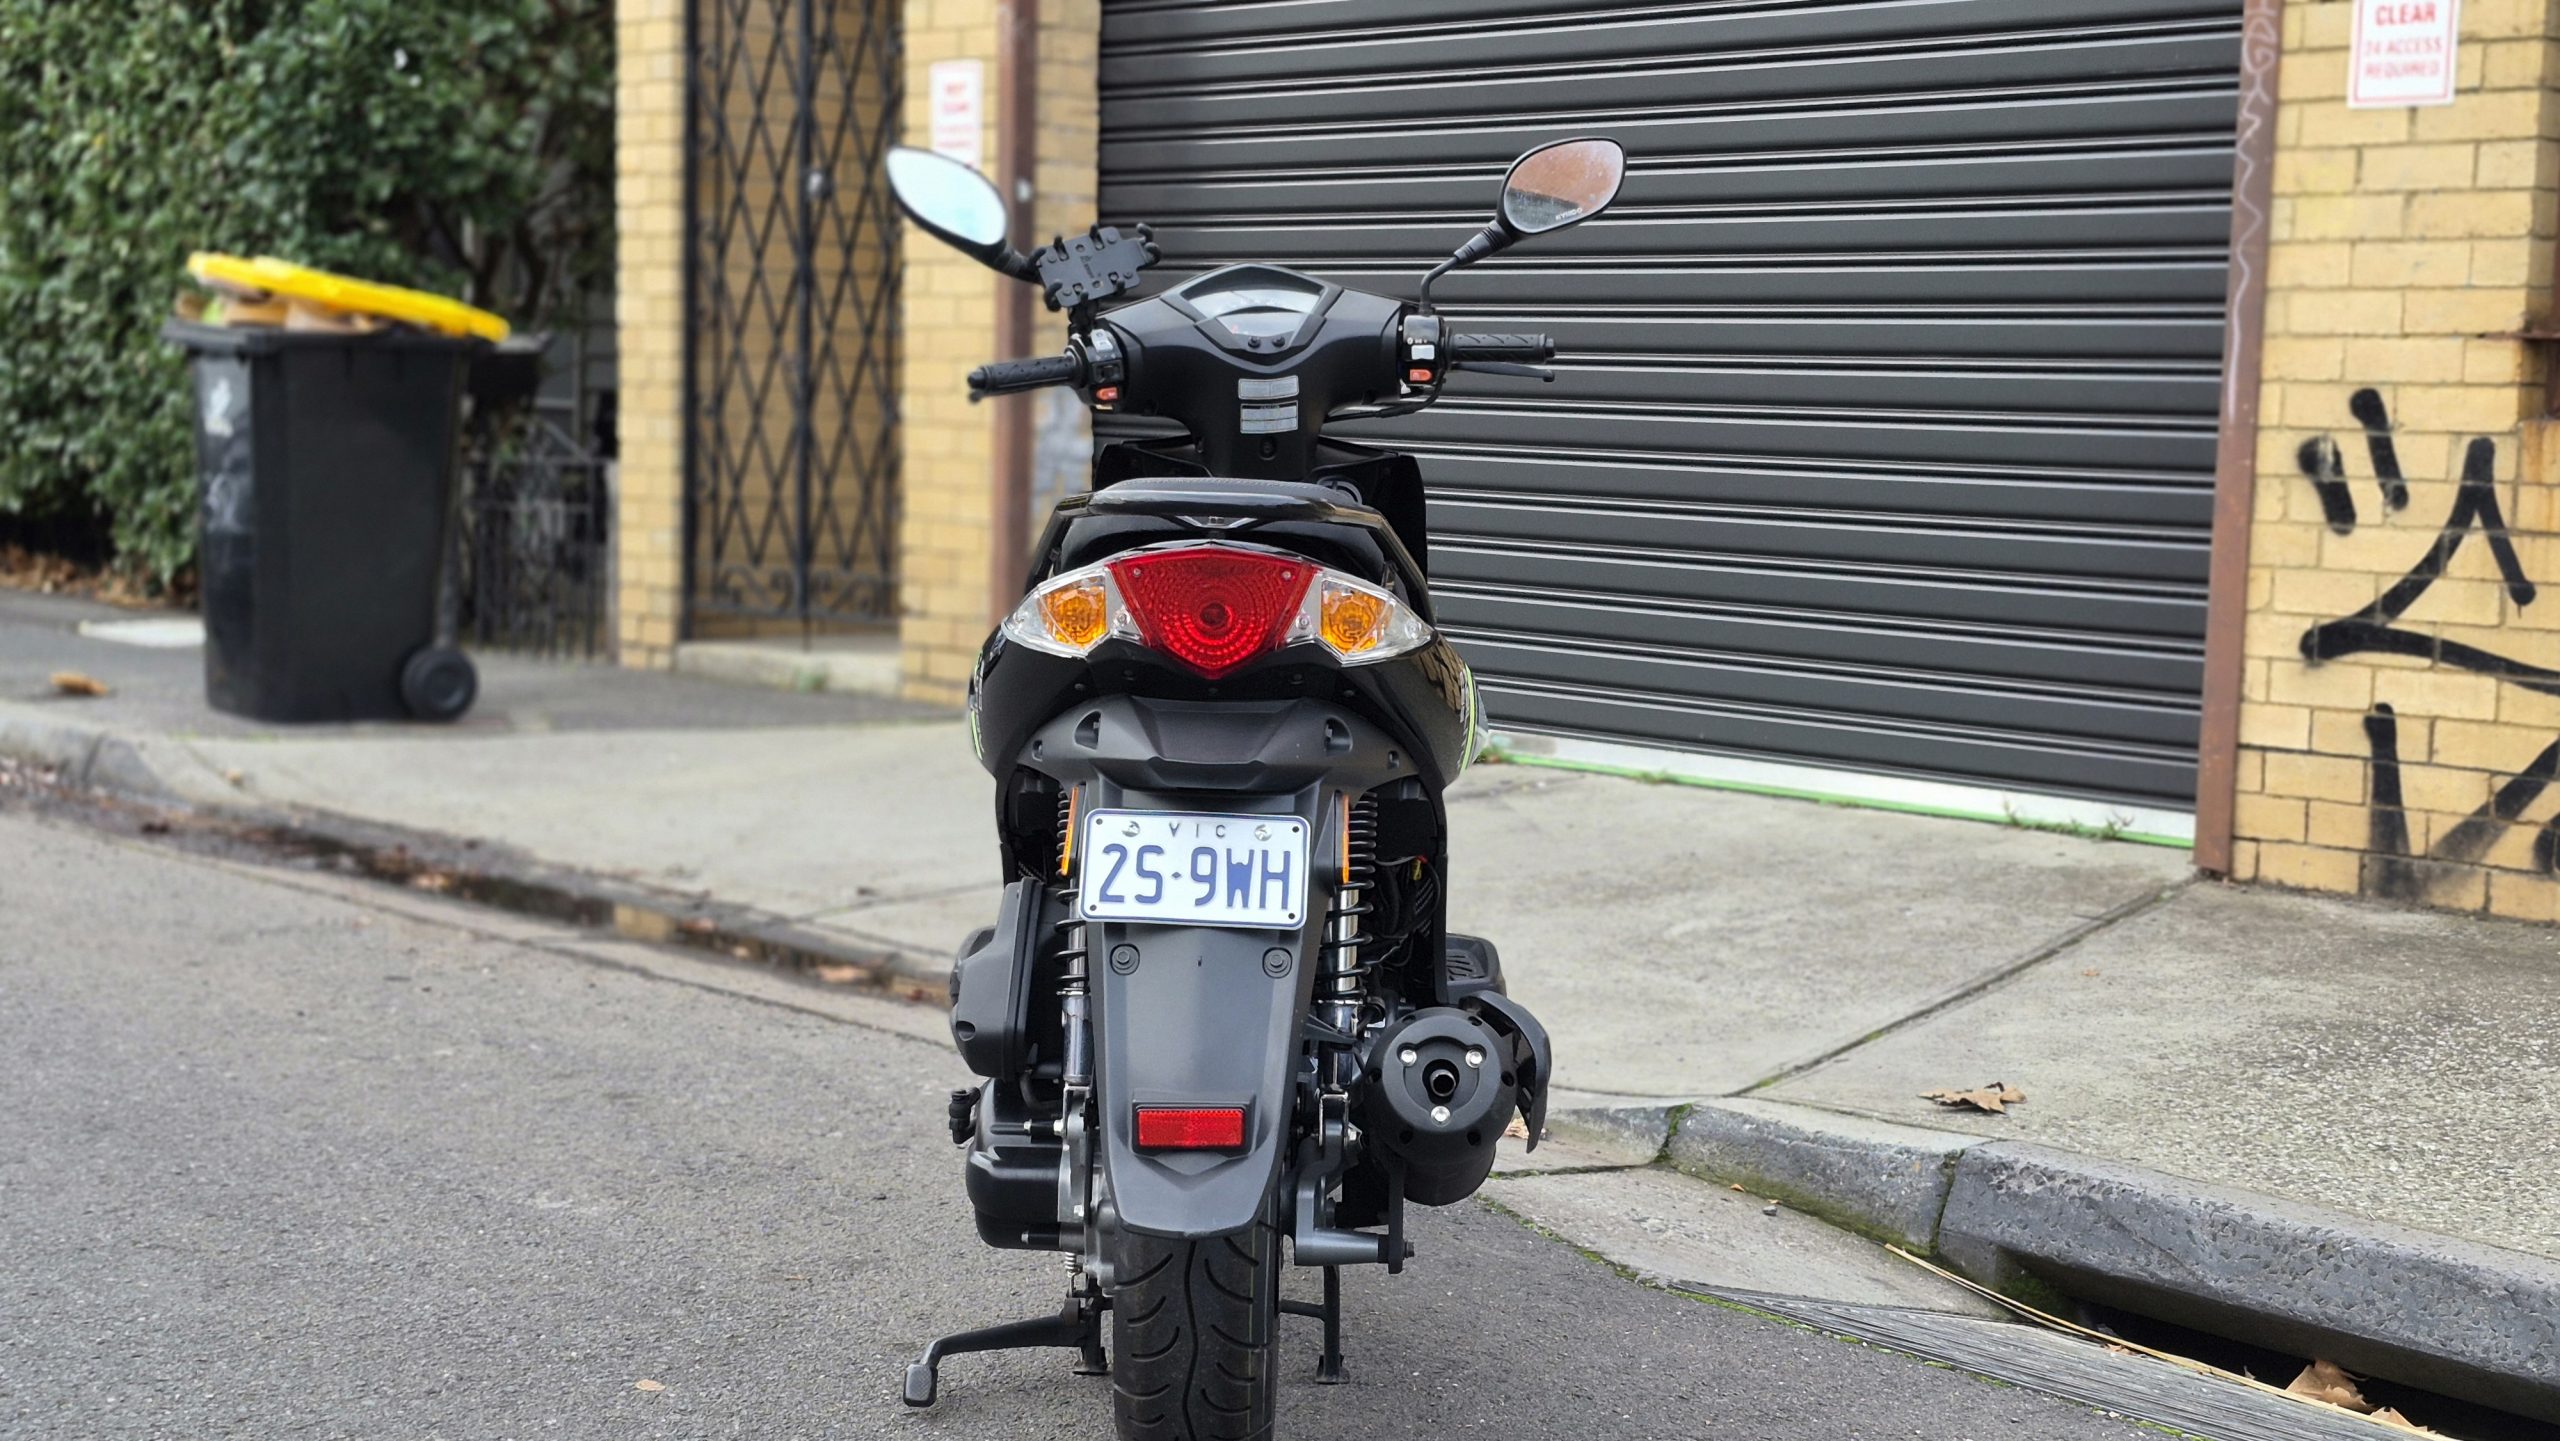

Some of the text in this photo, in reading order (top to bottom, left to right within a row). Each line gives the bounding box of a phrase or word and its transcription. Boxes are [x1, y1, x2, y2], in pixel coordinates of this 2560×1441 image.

[2375, 3, 2436, 26] CLEAR
[2387, 37, 2442, 54] ACCESS
[1168, 822, 1227, 839] VIC
